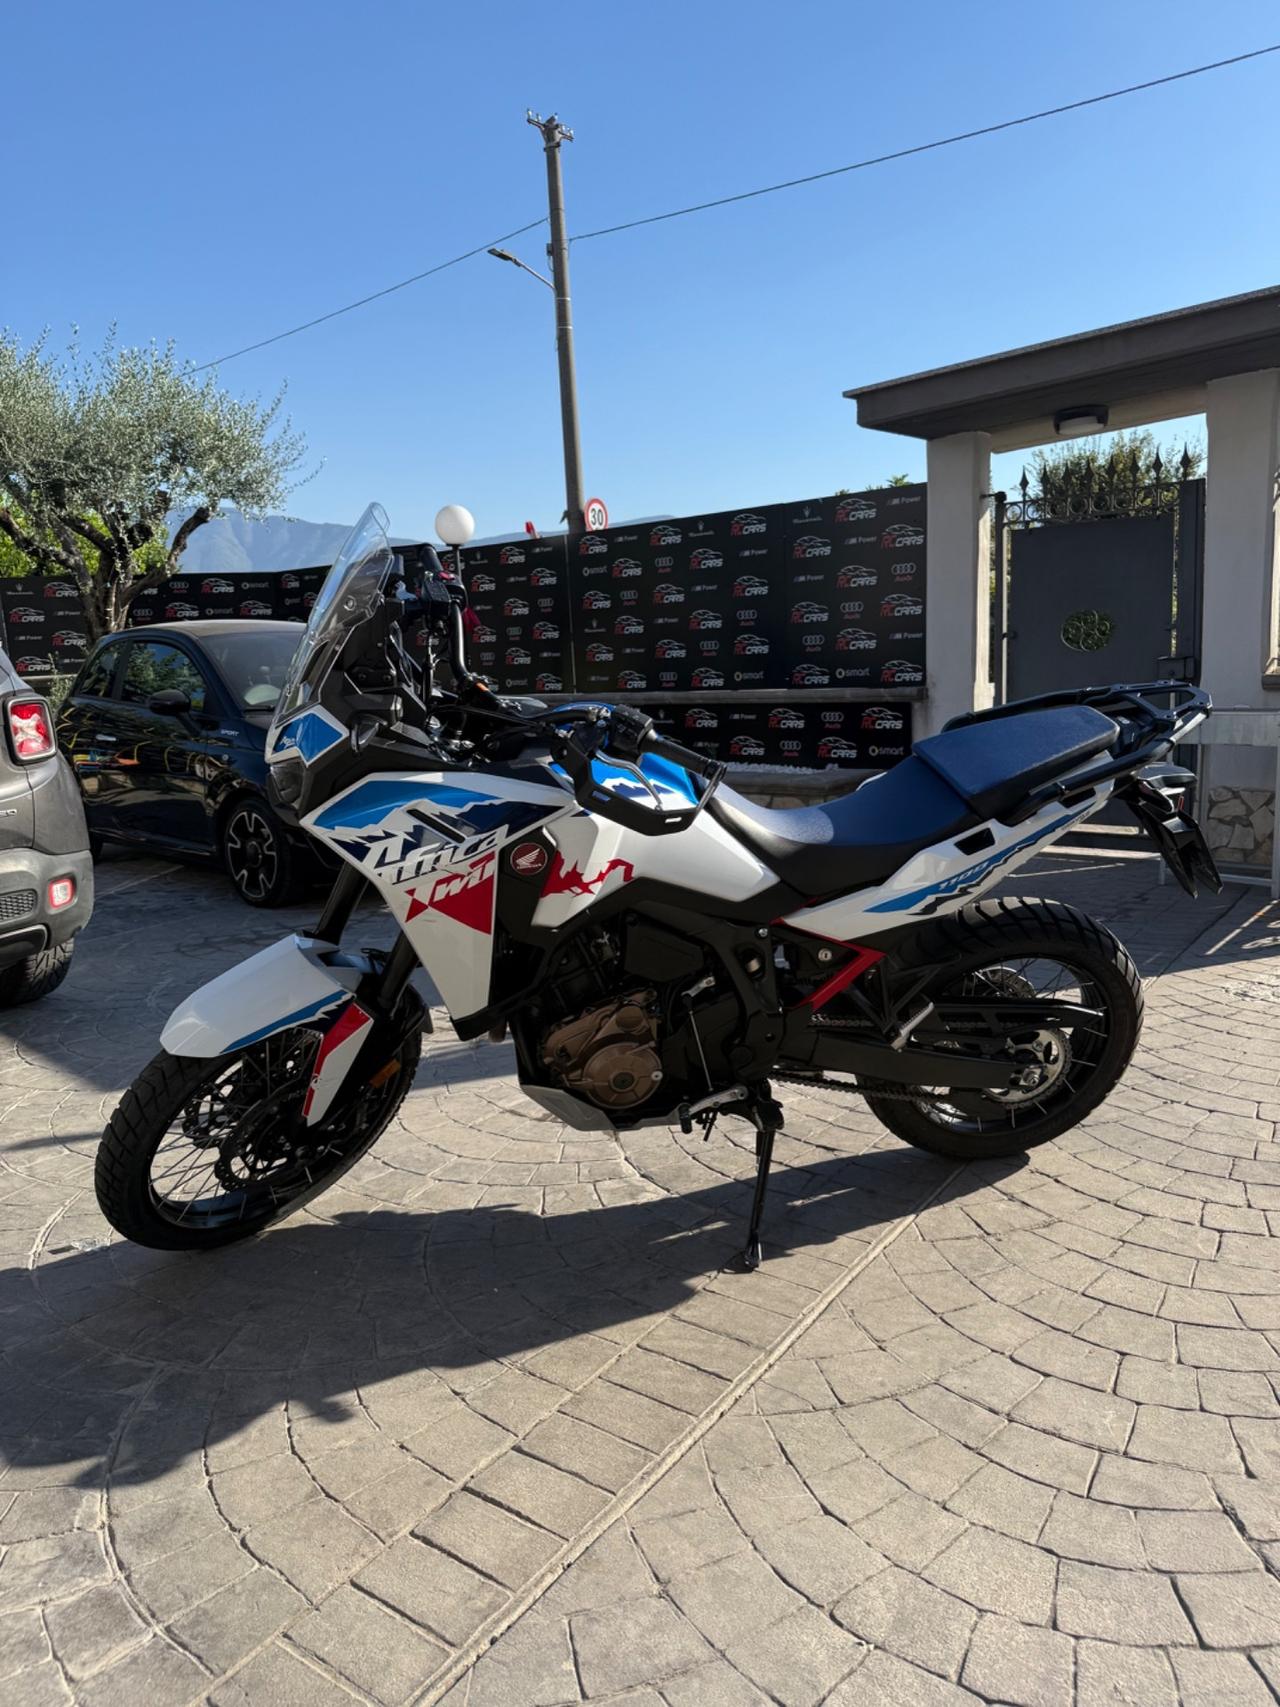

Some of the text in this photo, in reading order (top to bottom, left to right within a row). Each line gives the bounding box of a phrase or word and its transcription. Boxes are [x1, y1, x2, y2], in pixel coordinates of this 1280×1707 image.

[590, 508, 604, 526] 30
[849, 508, 876, 520] CARS
[896, 535, 924, 547] CARS
[806, 546, 831, 558] CARS
[850, 576, 878, 587] CARS
[894, 605, 923, 616] CARS
[850, 640, 877, 650] CARS
[846, 668, 870, 676] smart
[895, 672, 922, 681] CARS
[874, 720, 903, 729] CARS
[878, 747, 904, 756] smart
